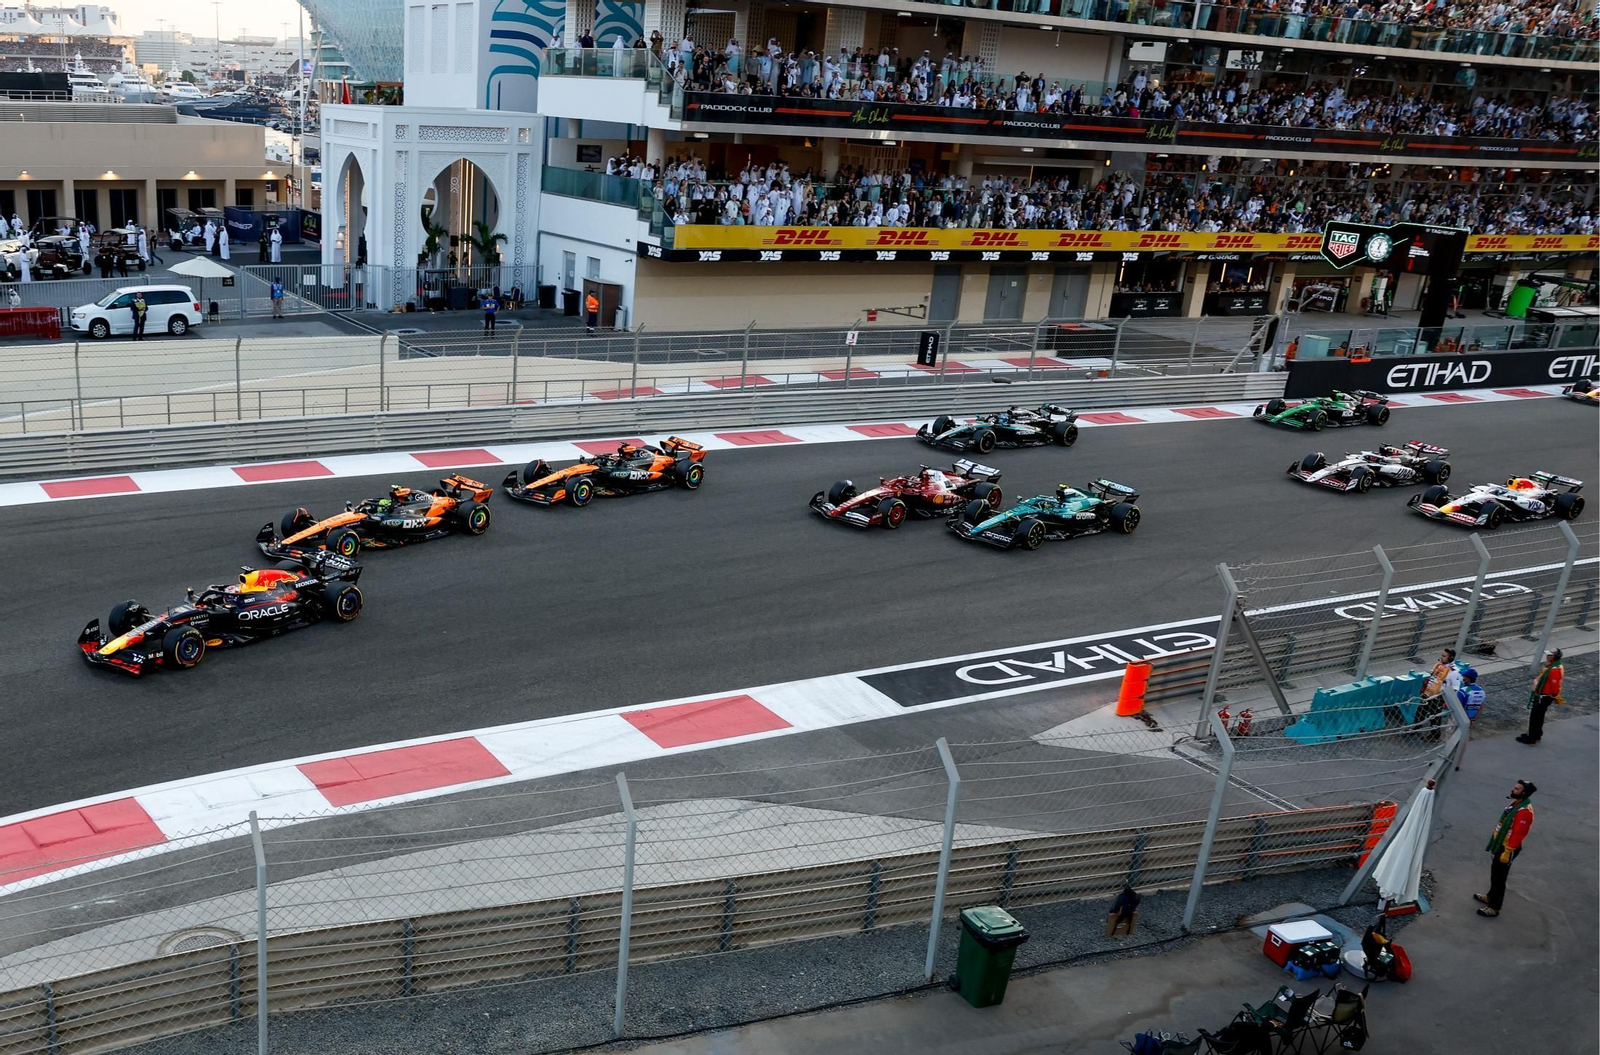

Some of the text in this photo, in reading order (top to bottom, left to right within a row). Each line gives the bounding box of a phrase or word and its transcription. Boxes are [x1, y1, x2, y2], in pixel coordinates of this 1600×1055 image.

[700, 104, 747, 112] PADDOCK
[773, 229, 831, 245] DHL
[876, 230, 931, 246] DHL
[971, 232, 1020, 246] DHL
[1059, 233, 1104, 247] DHL
[1139, 234, 1181, 248] DHL
[1214, 235, 1254, 248] DHL
[1286, 235, 1322, 248] DHL
[1333, 233, 1356, 243] TAG
[1474, 237, 1508, 249] DHL
[1531, 237, 1563, 249] DHL
[647, 245, 662, 258] YAS
[1329, 242, 1355, 257] HEUER
[698, 251, 721, 261] YAS
[760, 251, 782, 261] YAS
[819, 251, 841, 261] YAS
[876, 251, 897, 261] YAS
[931, 251, 950, 261] YAS
[981, 251, 1001, 261] YAS
[1031, 252, 1051, 261] YAS
[1076, 252, 1094, 261] YAS
[1122, 252, 1139, 261] YAS
[924, 336, 934, 363] ETIHAD
[1548, 354, 1599, 378] ETIH
[1386, 360, 1492, 388] ETIHAD
[295, 578, 318, 588] HONDA
[238, 604, 289, 620] ORACLE
[955, 632, 1217, 685] ETIHAD
